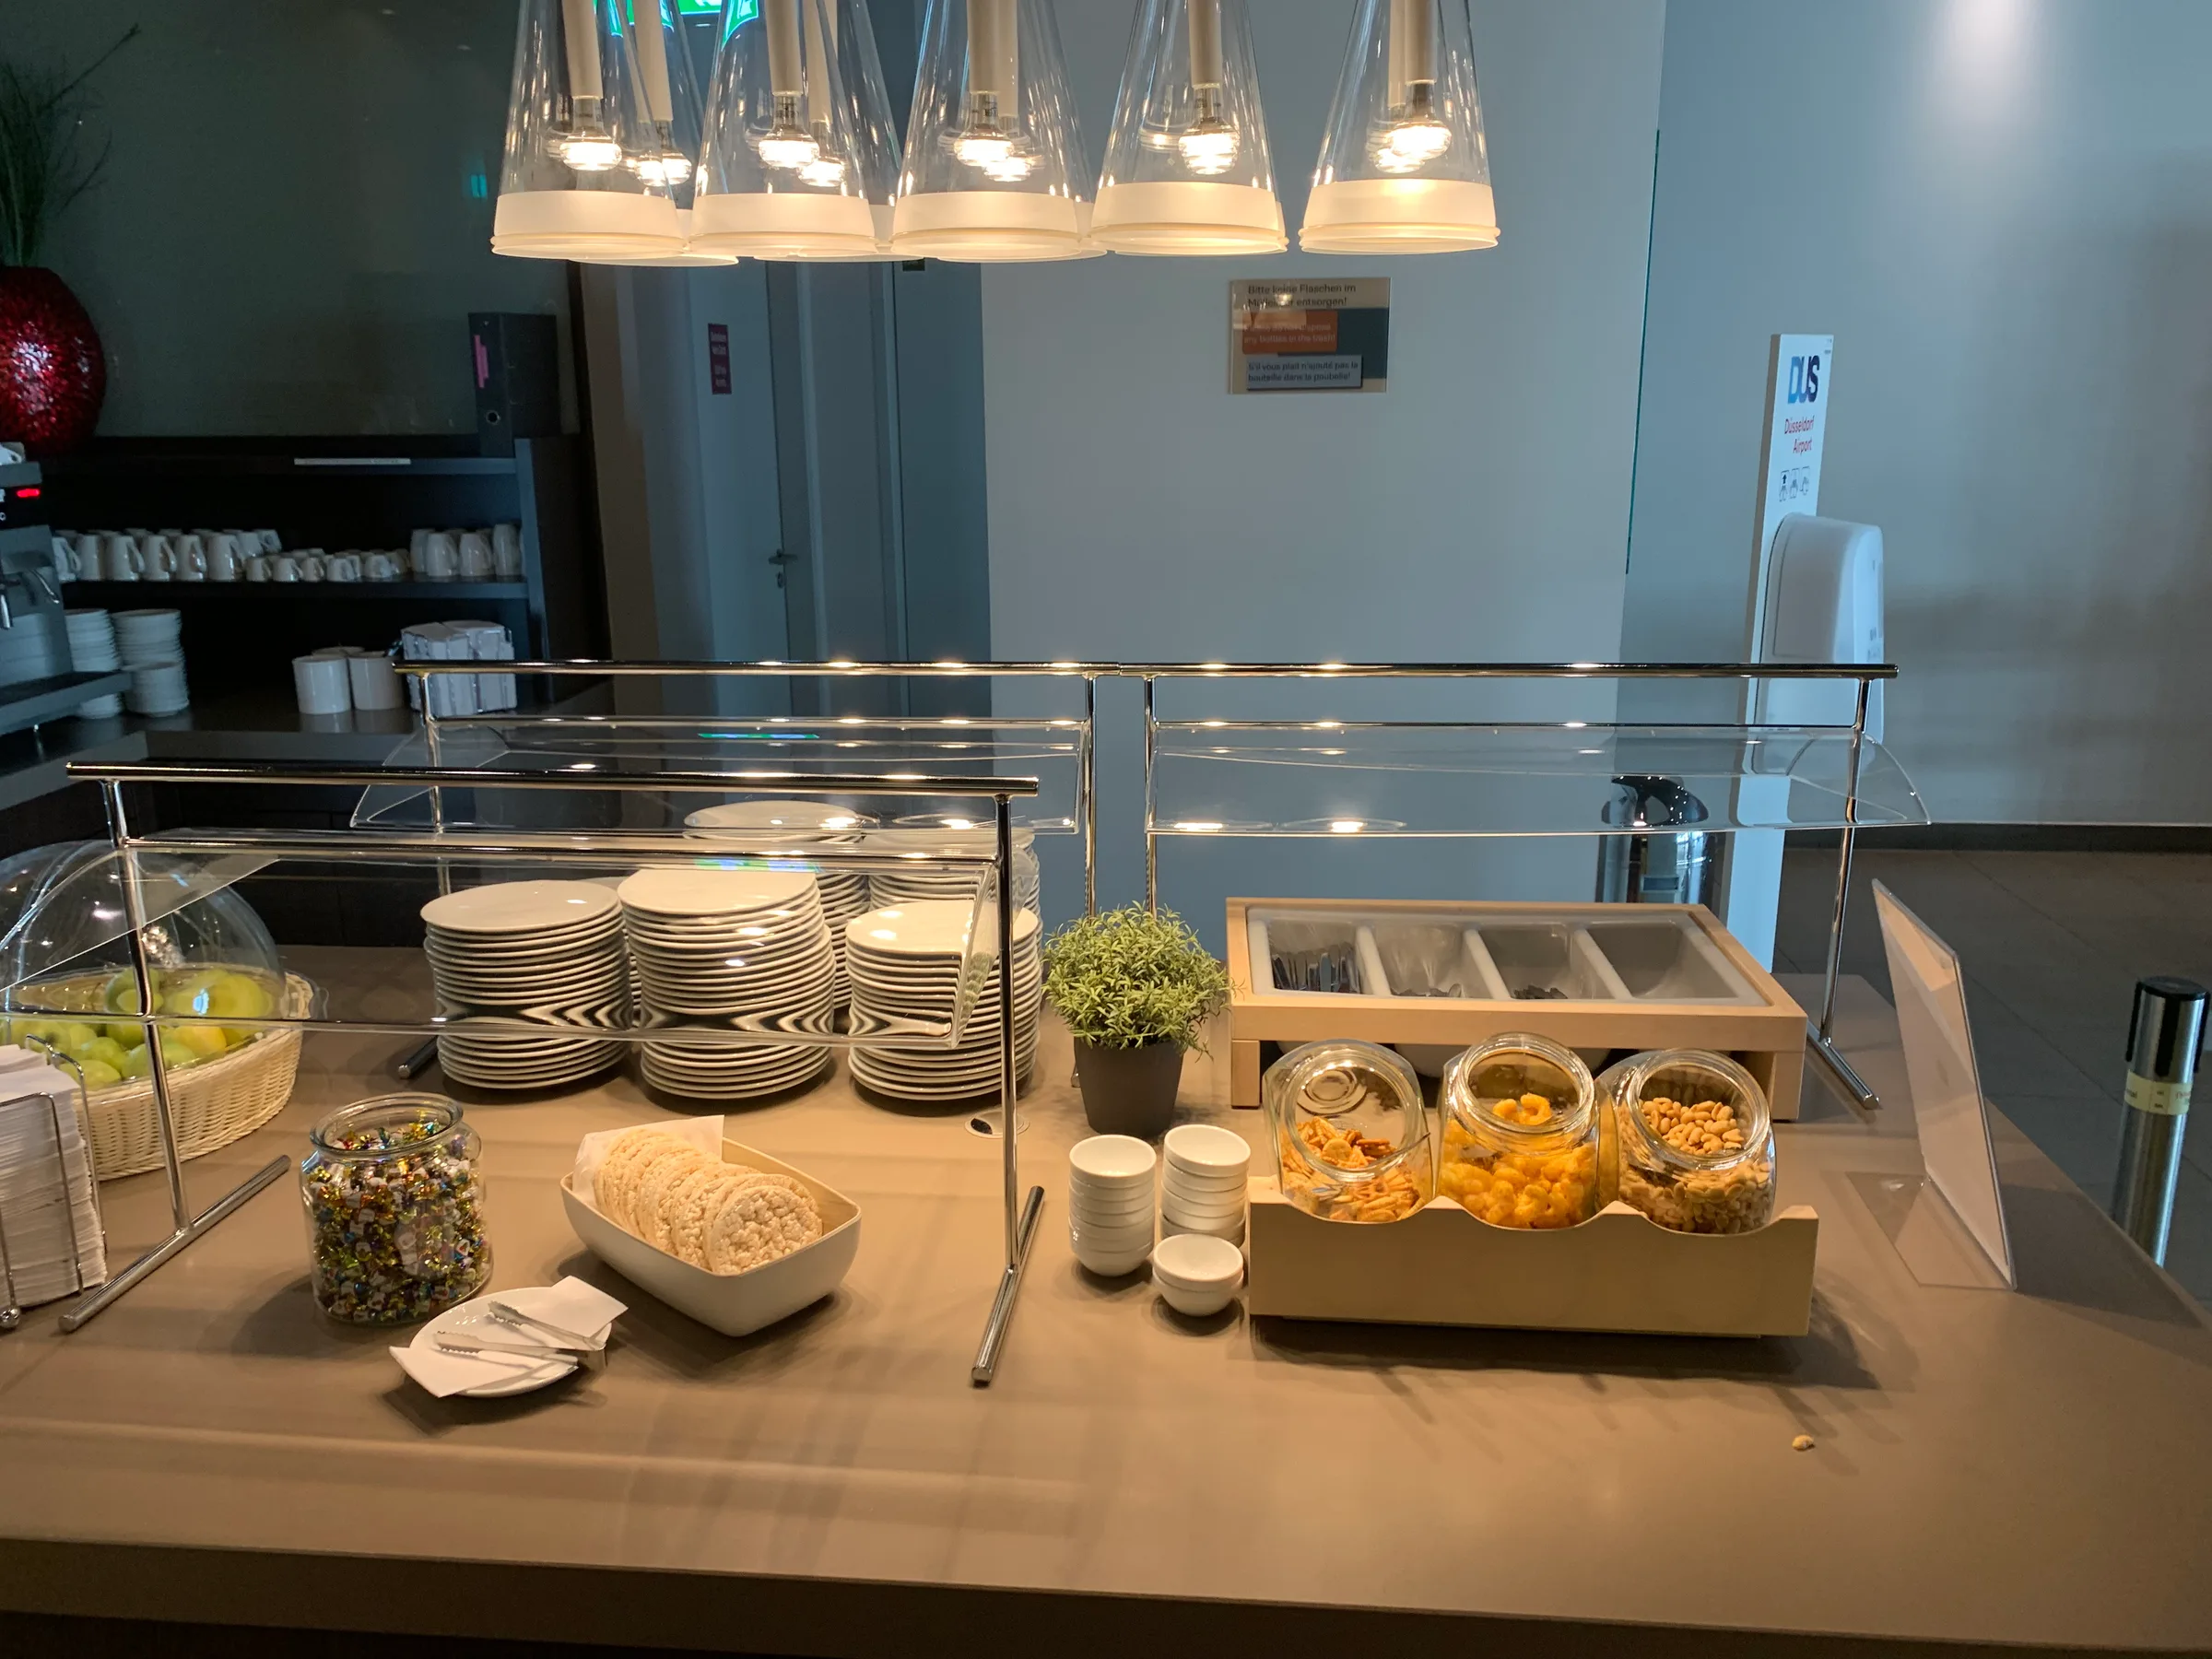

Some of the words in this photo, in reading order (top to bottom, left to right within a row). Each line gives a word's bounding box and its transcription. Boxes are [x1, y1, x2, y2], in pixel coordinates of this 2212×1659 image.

[1248, 285, 1271, 294] Bitte
[1273, 284, 1298, 294] keine
[1300, 283, 1342, 294] Flaschen
[1344, 283, 1357, 293] im
[1296, 296, 1347, 308] entsorgen!
[1335, 362, 1349, 371] pas
[1350, 360, 1359, 369] la
[1283, 372, 1302, 381] dans
[1304, 372, 1312, 381] la
[1787, 355, 1820, 404] DUS
[1783, 415, 1816, 435] Düsseldorf
[1792, 437, 1813, 456] Airport
